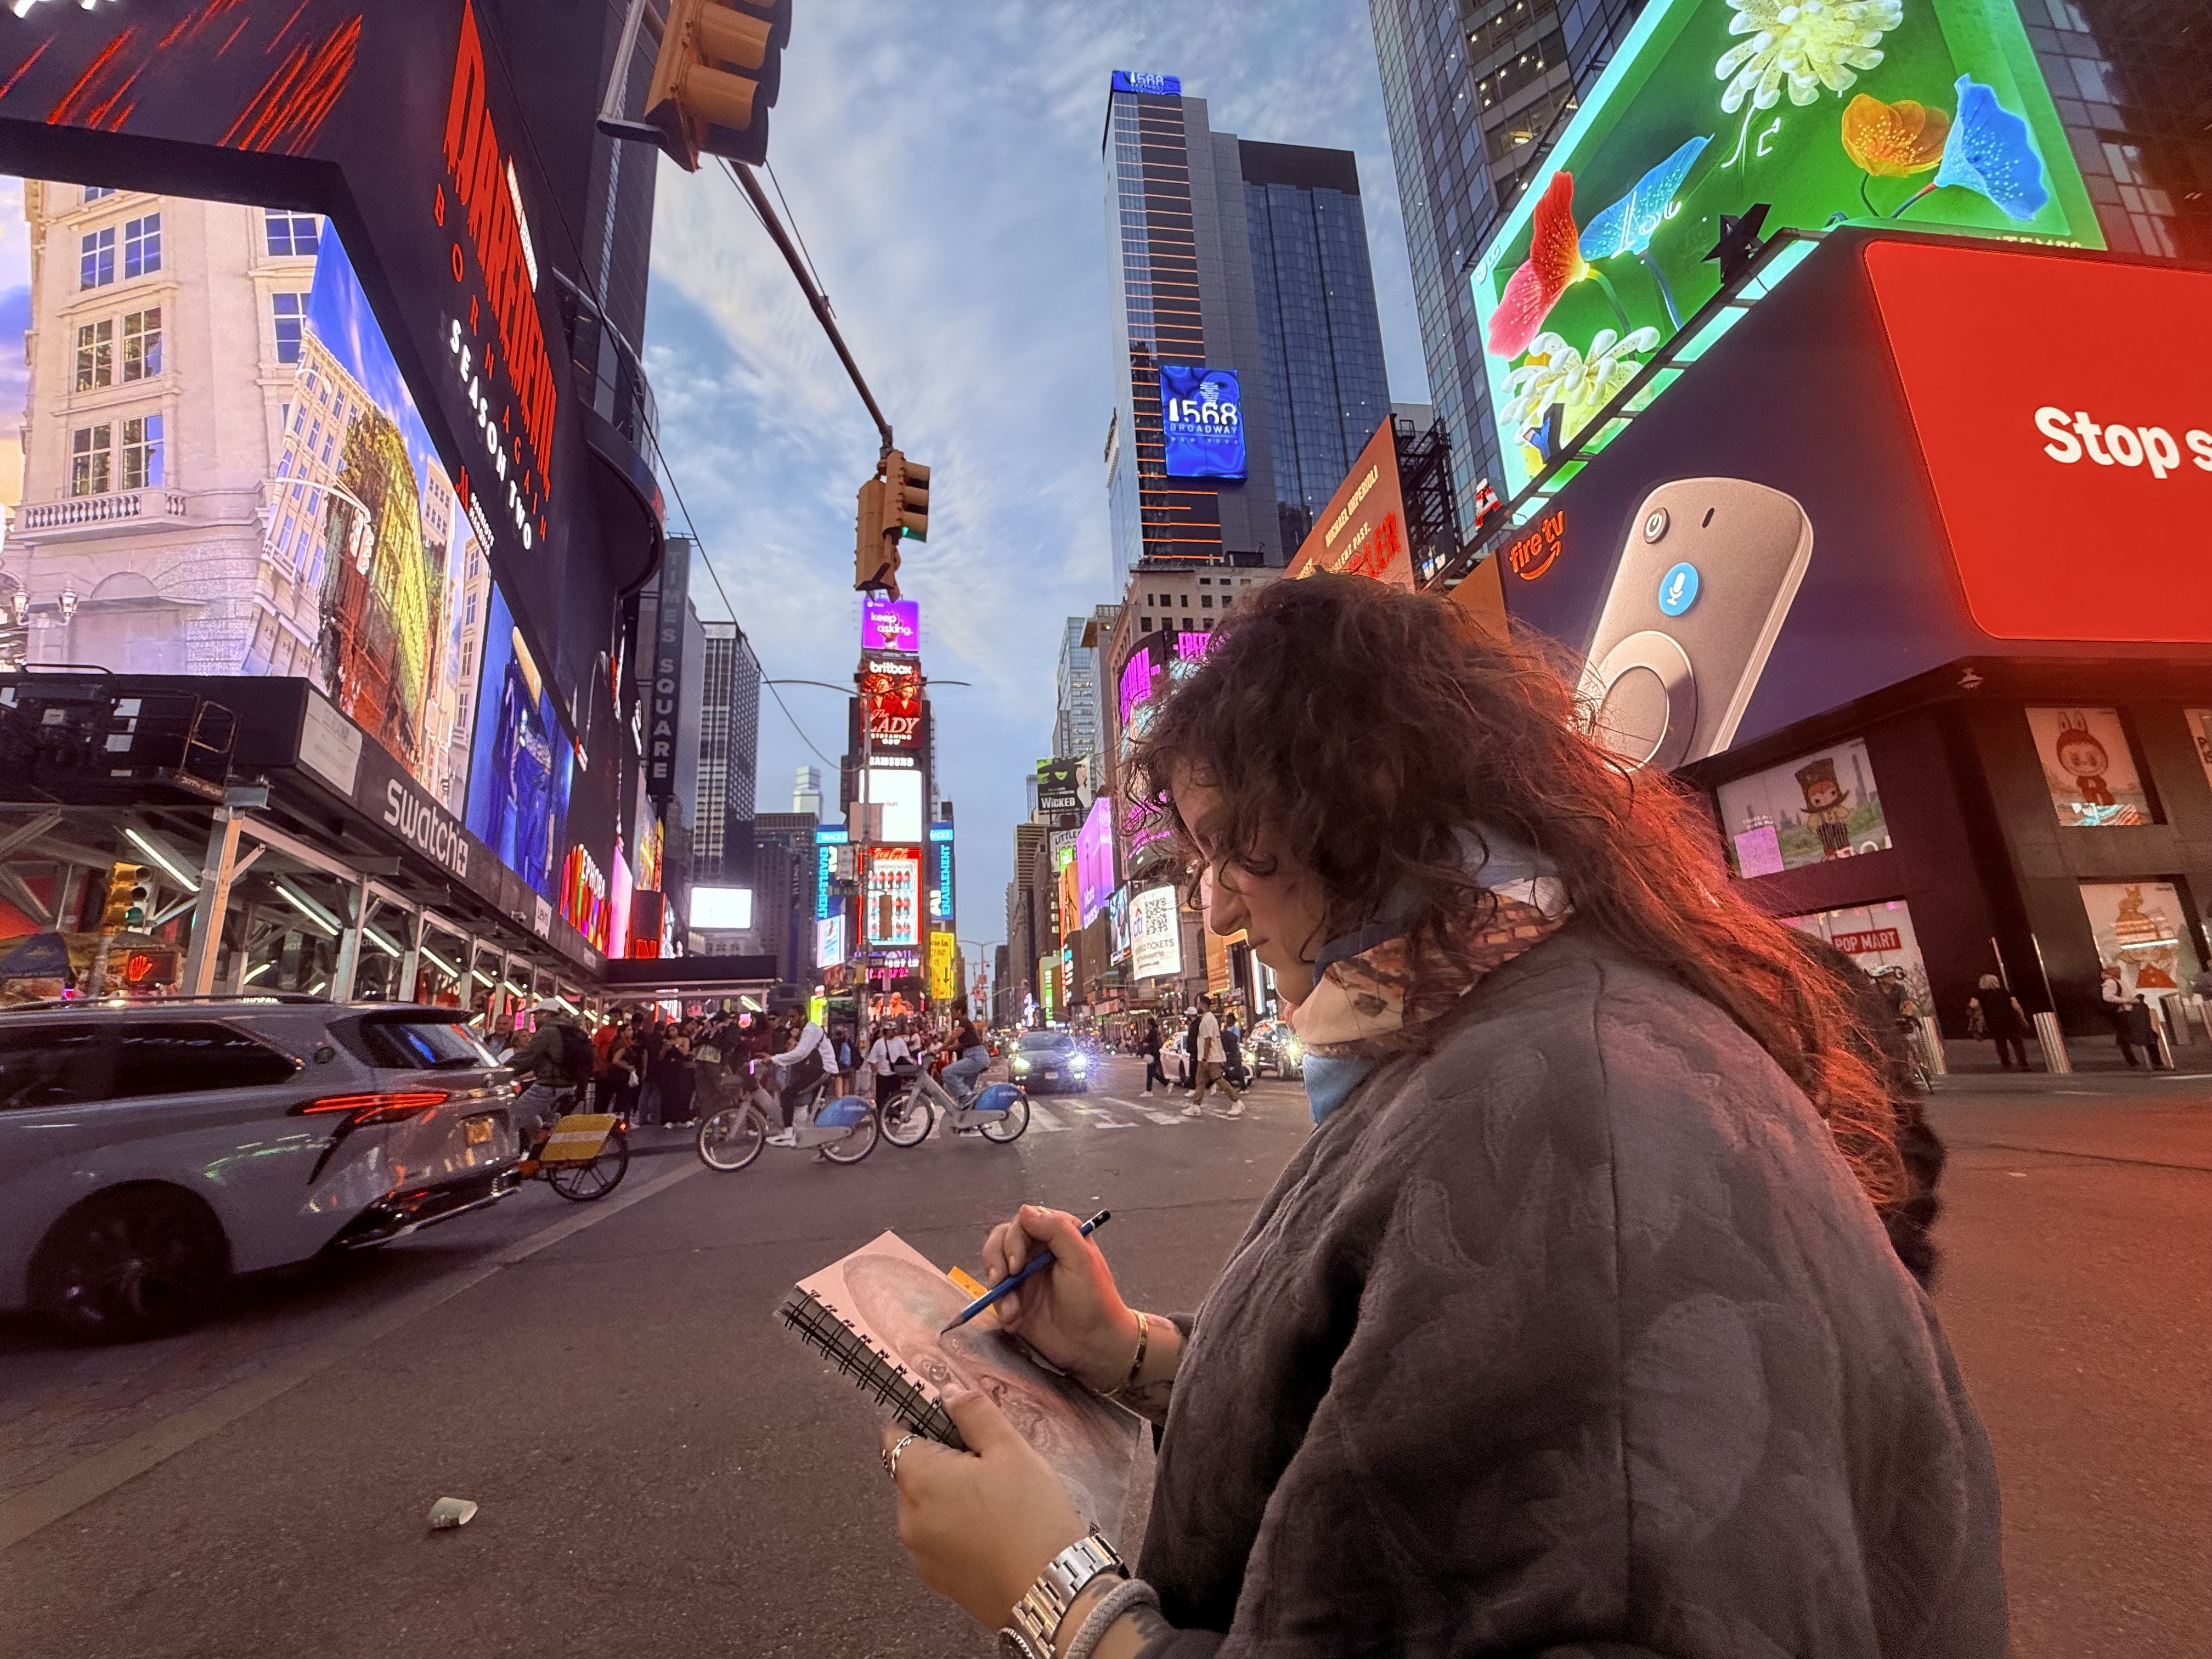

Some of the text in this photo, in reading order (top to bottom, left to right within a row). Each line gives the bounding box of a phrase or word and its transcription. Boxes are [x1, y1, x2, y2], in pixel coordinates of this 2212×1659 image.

[1130, 71, 1164, 86] 1568
[443, 0, 556, 501] DAREDEVIL
[433, 183, 546, 541] BORN AGAIN
[1169, 398, 1238, 425] 1568
[1170, 424, 1238, 434] BROADWAY
[450, 319, 532, 550] SEASON TWO
[2034, 407, 2181, 479] Stop
[471, 492, 494, 546] MARRIOTT
[1325, 464, 1379, 548] MICHAEL IMPERIOLI
[469, 507, 490, 556] MARQUIS
[1509, 510, 1565, 573] fire tv
[871, 612, 897, 625] keep
[877, 624, 913, 636] asking.
[653, 552, 681, 779] TIMES SQUARE
[870, 661, 912, 674] britbox
[870, 709, 890, 720] The
[869, 756, 914, 767] SAMSUNG
[384, 778, 459, 871] swatch
[1055, 831, 1076, 845] LITTLE
[941, 844, 951, 916] ENABLEMENT
[1147, 939, 1175, 950] TICKETS
[1834, 931, 1896, 952] POP MART
